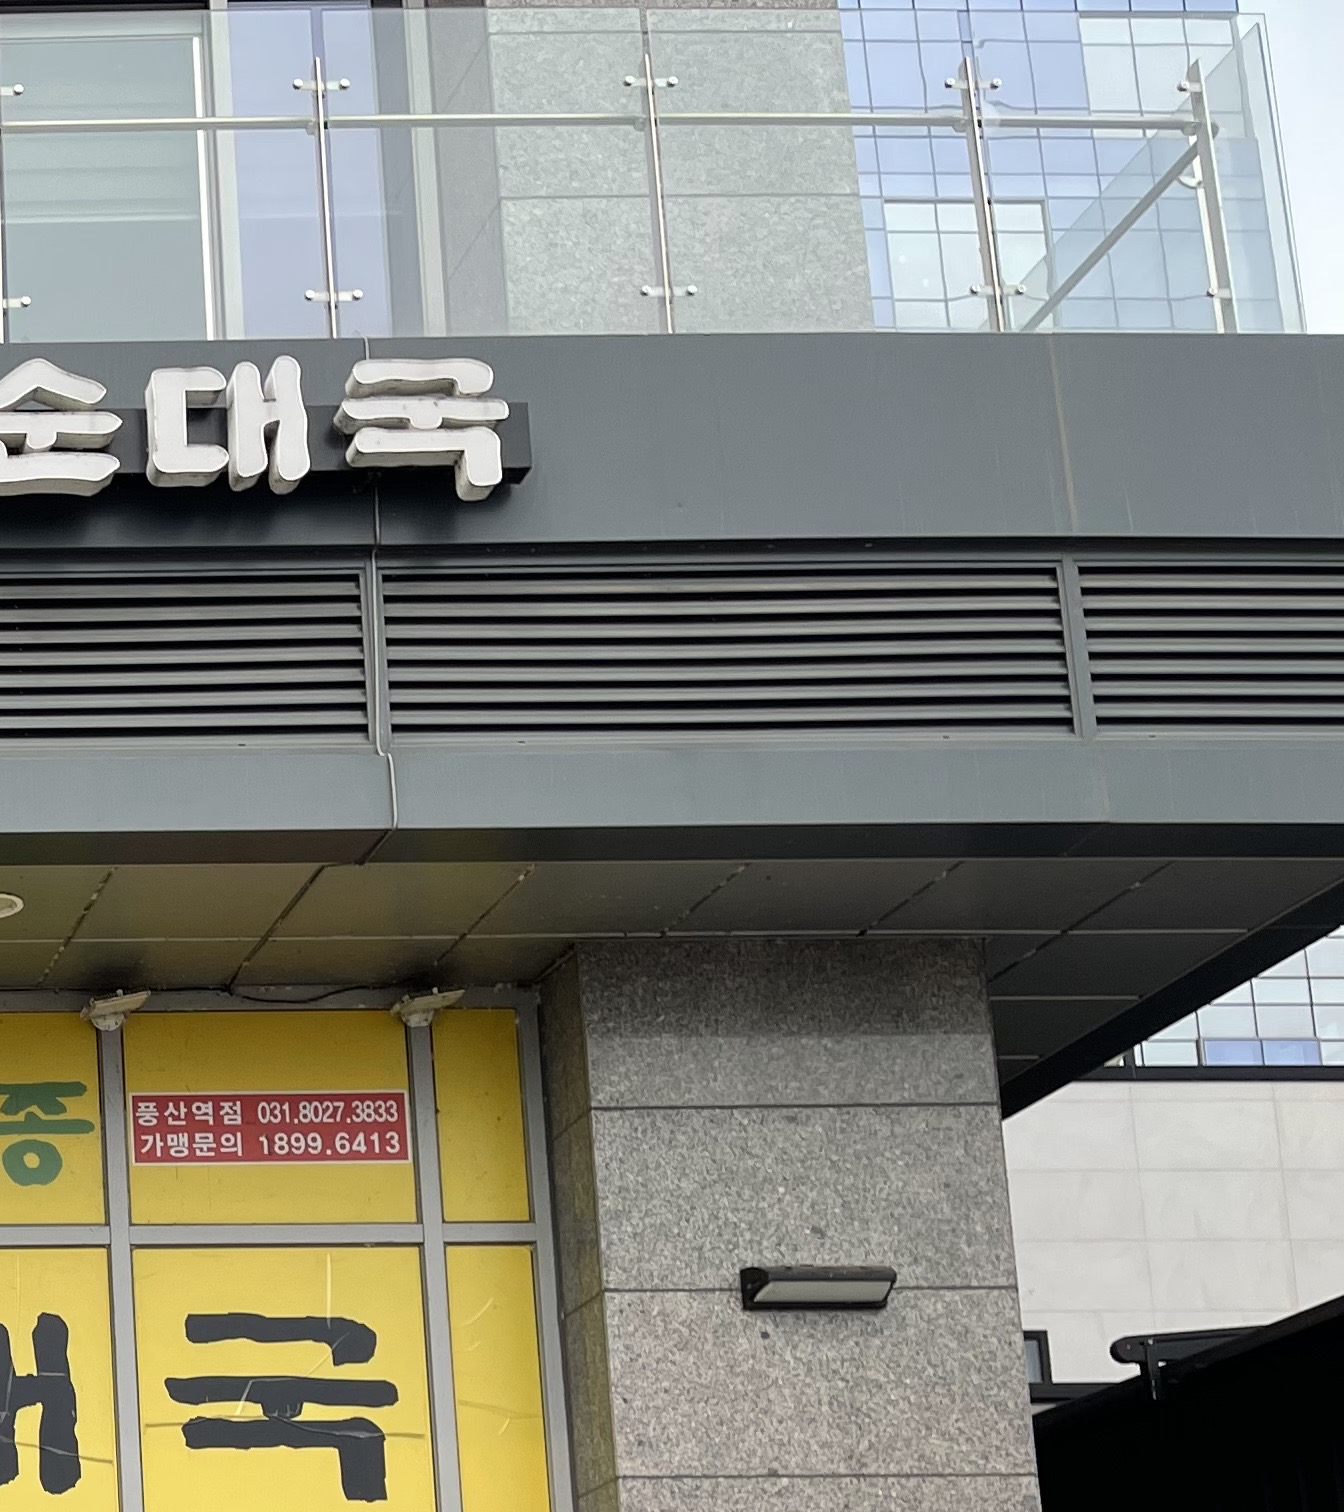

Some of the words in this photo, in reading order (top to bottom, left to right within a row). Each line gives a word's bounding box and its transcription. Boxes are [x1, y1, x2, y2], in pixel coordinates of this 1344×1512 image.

[135, 1101, 242, 1126] 풍산역점
[257, 1100, 398, 1124] 031.8027.3833
[140, 1132, 243, 1157] 가맹문의
[259, 1131, 400, 1156] 1899.6413
